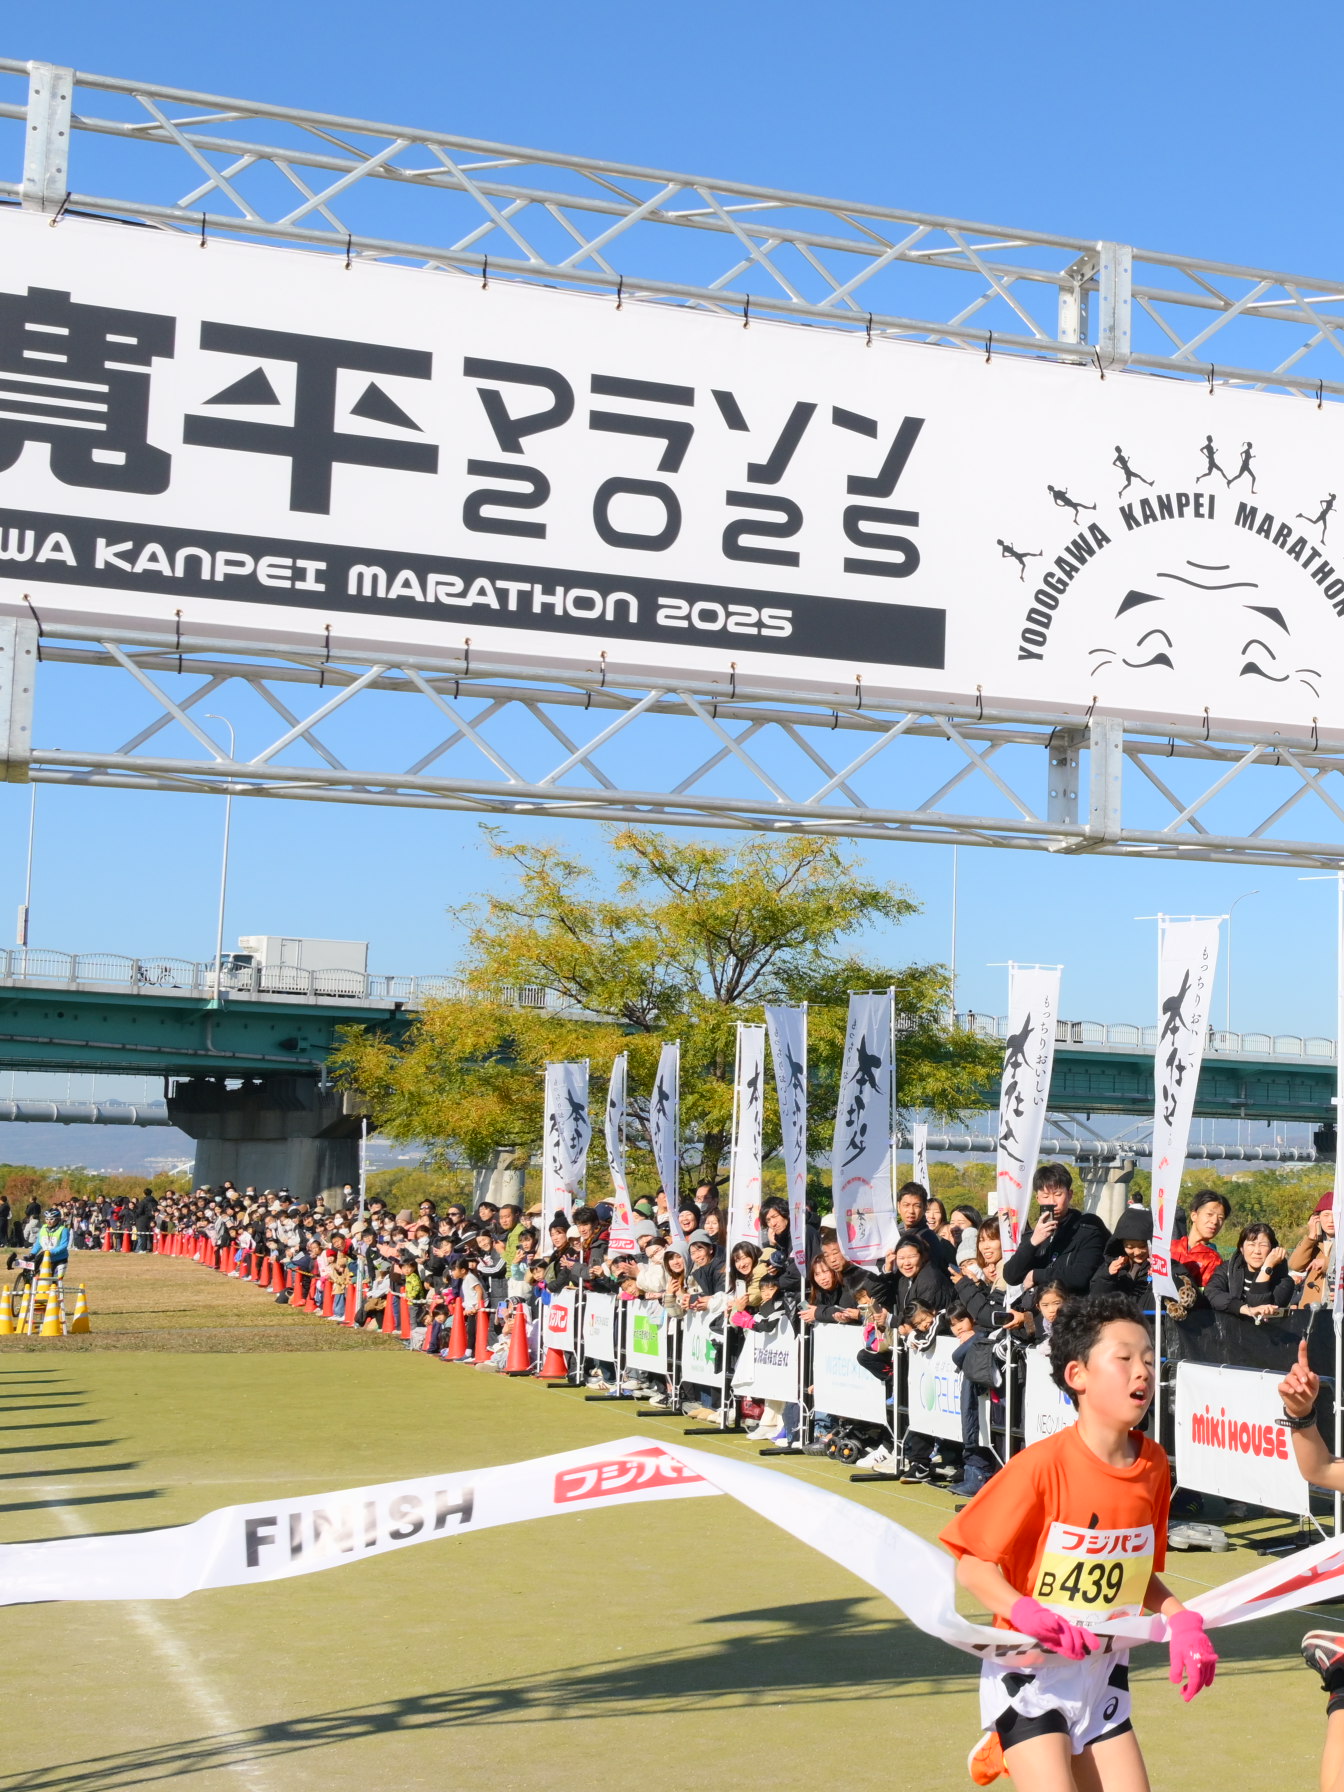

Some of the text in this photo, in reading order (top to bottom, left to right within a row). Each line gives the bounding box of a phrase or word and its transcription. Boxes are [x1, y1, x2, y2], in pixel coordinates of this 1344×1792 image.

[462, 458, 922, 579] 2025
[96, 537, 328, 592] KANPEI
[348, 564, 639, 624] MARATHON
[657, 603, 794, 638] 2025
[1018, 522, 1112, 661] YODOGAWA
[1119, 492, 1216, 532] KANPEI
[1033, 995, 1050, 1106] もっちりおいしい
[1228, 1419, 1288, 1460] HOUSE
[245, 1488, 475, 1568] FINISH
[1062, 1531, 1148, 1554] フジパン
